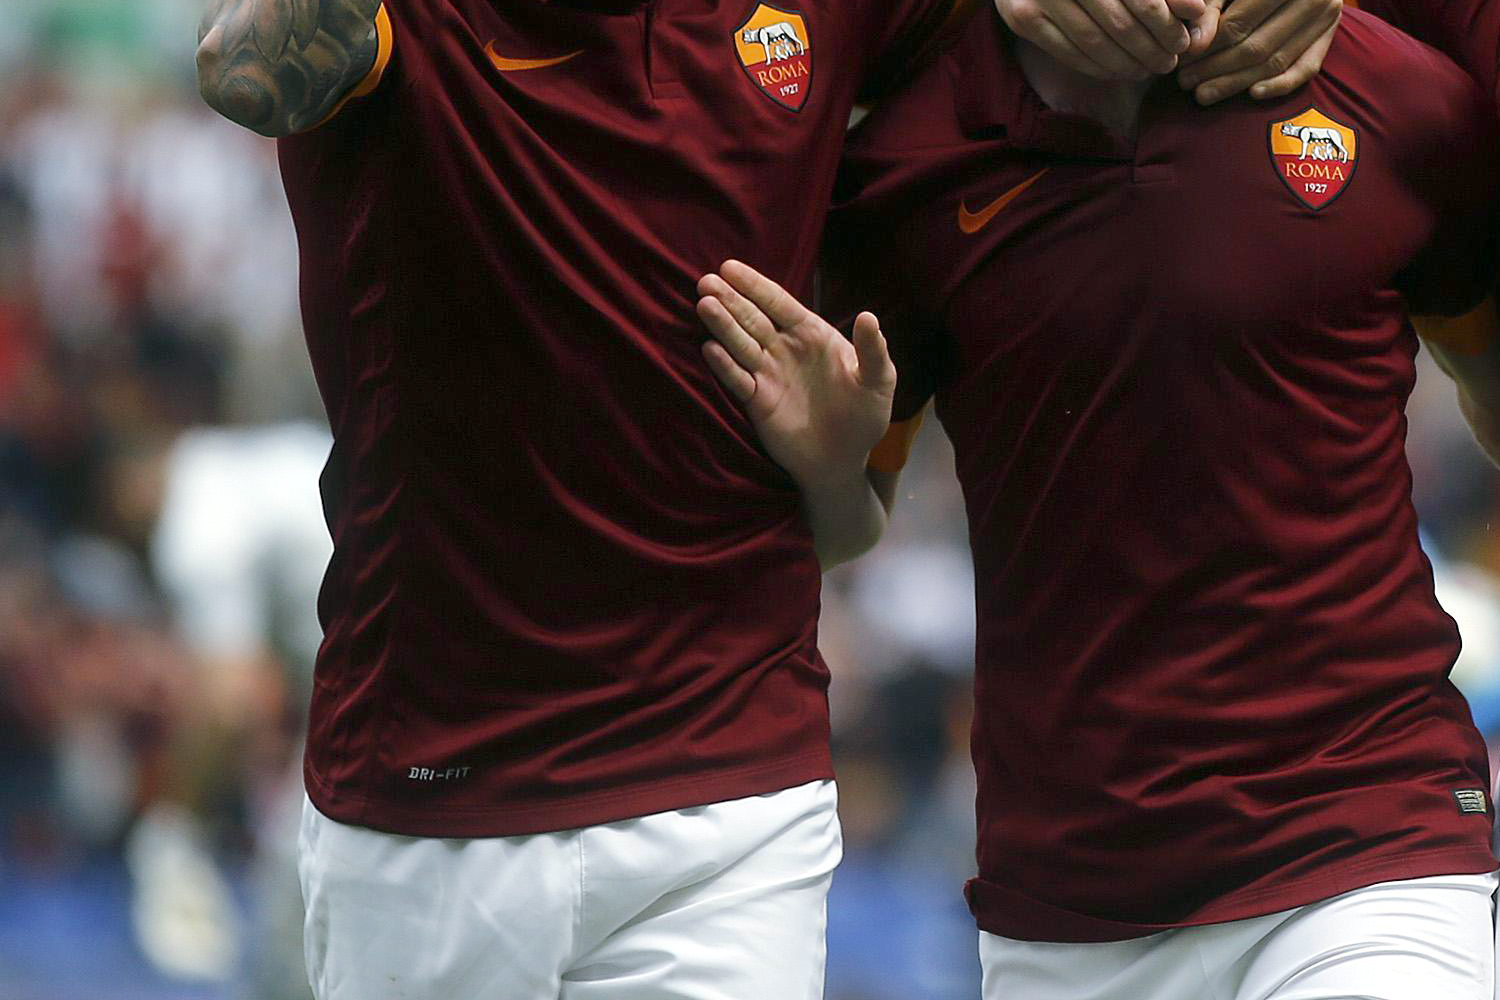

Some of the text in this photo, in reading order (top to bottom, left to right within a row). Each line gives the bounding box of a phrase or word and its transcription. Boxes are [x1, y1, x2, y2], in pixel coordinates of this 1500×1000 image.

[757, 60, 809, 87] ROMA
[779, 83, 799, 97] 1927
[1285, 162, 1344, 181] ROMA
[1304, 182, 1328, 194] 1927
[407, 766, 472, 781] DRI-FIT
